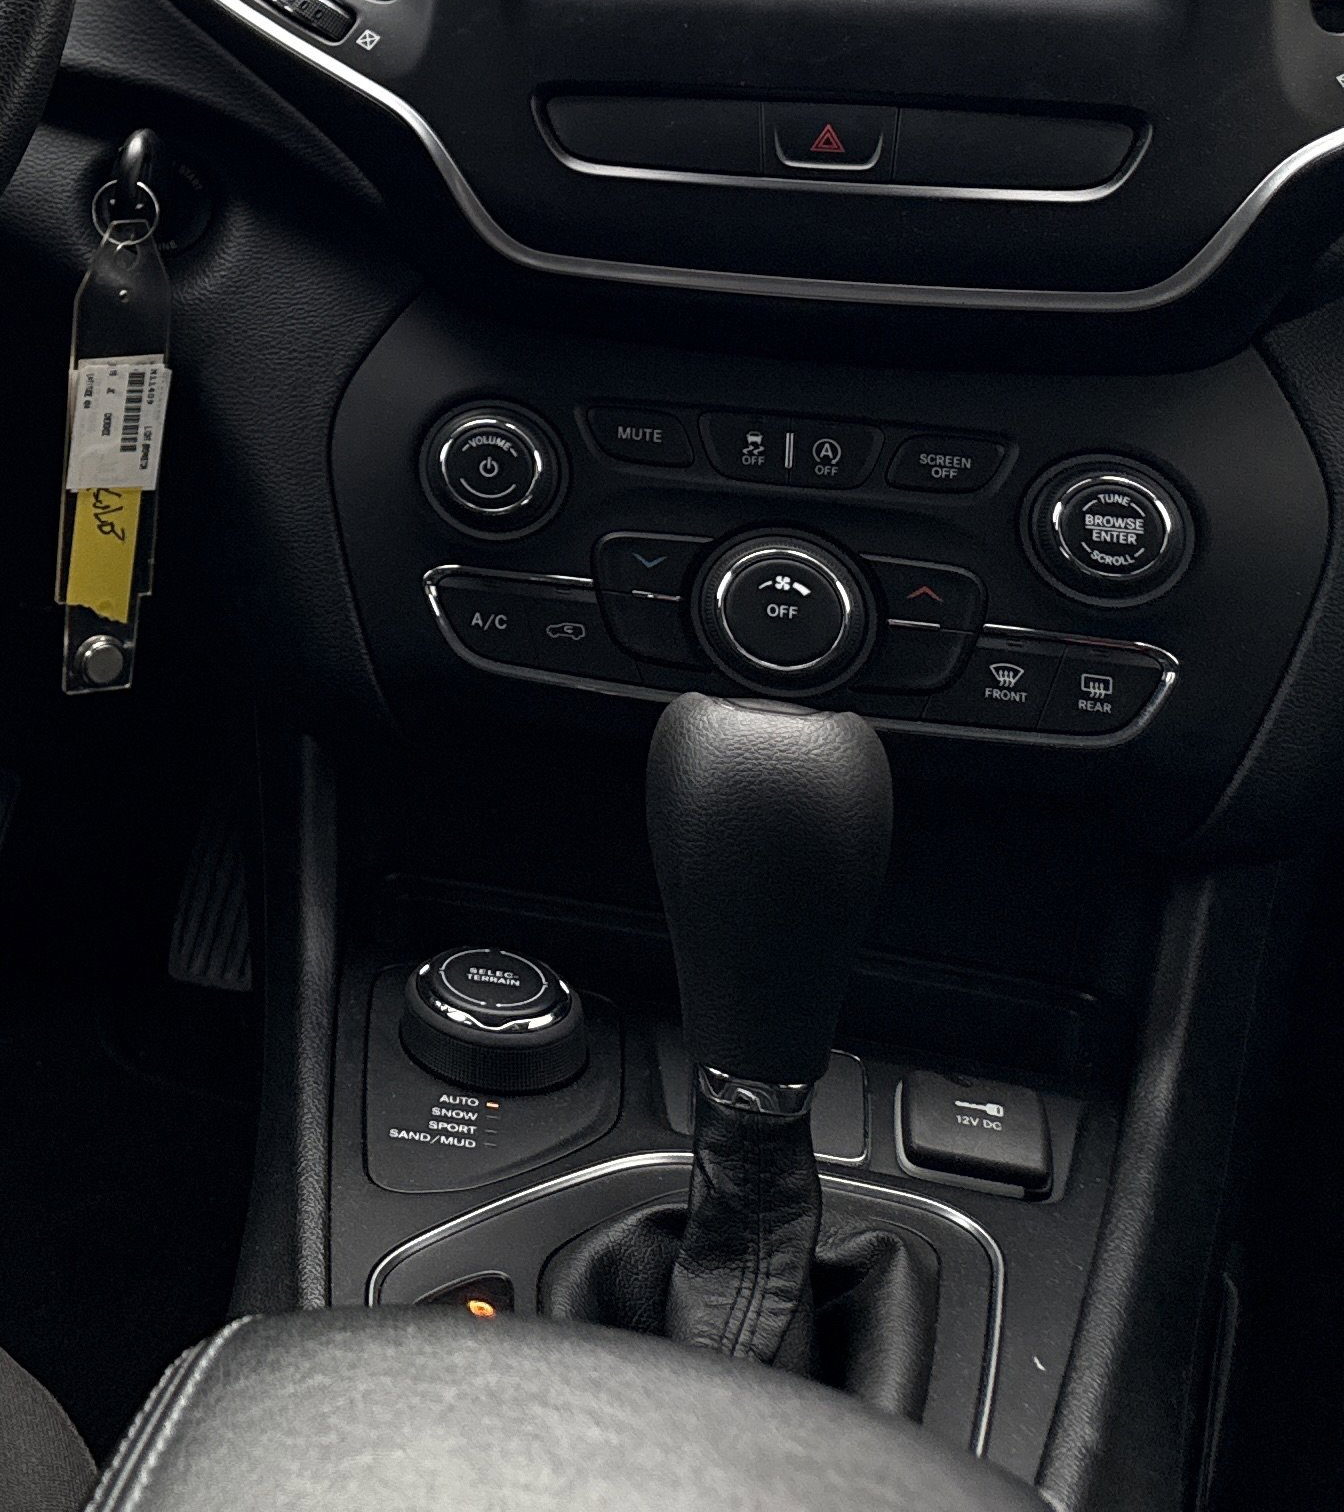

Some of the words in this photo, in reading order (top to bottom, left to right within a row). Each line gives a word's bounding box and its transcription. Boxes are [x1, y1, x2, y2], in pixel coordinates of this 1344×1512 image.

[617, 426, 663, 443] MUTE
[467, 435, 511, 452] VOLUME
[742, 455, 765, 466] OFF
[919, 453, 972, 469] SCREEN
[814, 464, 838, 476] OFF
[931, 467, 958, 479] OFF
[1097, 493, 1131, 507] TUNE
[1085, 514, 1144, 530] BROWSE
[1092, 530, 1137, 545] ENTER
[1090, 550, 1135, 566] SCROLL
[766, 604, 798, 620] OFF
[471, 612, 508, 630] A/C
[984, 687, 1028, 703] FRONT
[1078, 699, 1112, 714] REAR
[467, 973, 520, 987] TERRAIN
[469, 967, 520, 979] SELEC-
[439, 1094, 479, 1107] AUTO
[432, 1106, 478, 1121] SNOW
[428, 1120, 477, 1135] SPORT
[955, 1114, 980, 1127] 12V
[982, 1119, 1002, 1131] DC
[389, 1128, 476, 1148] SAND/MUD
